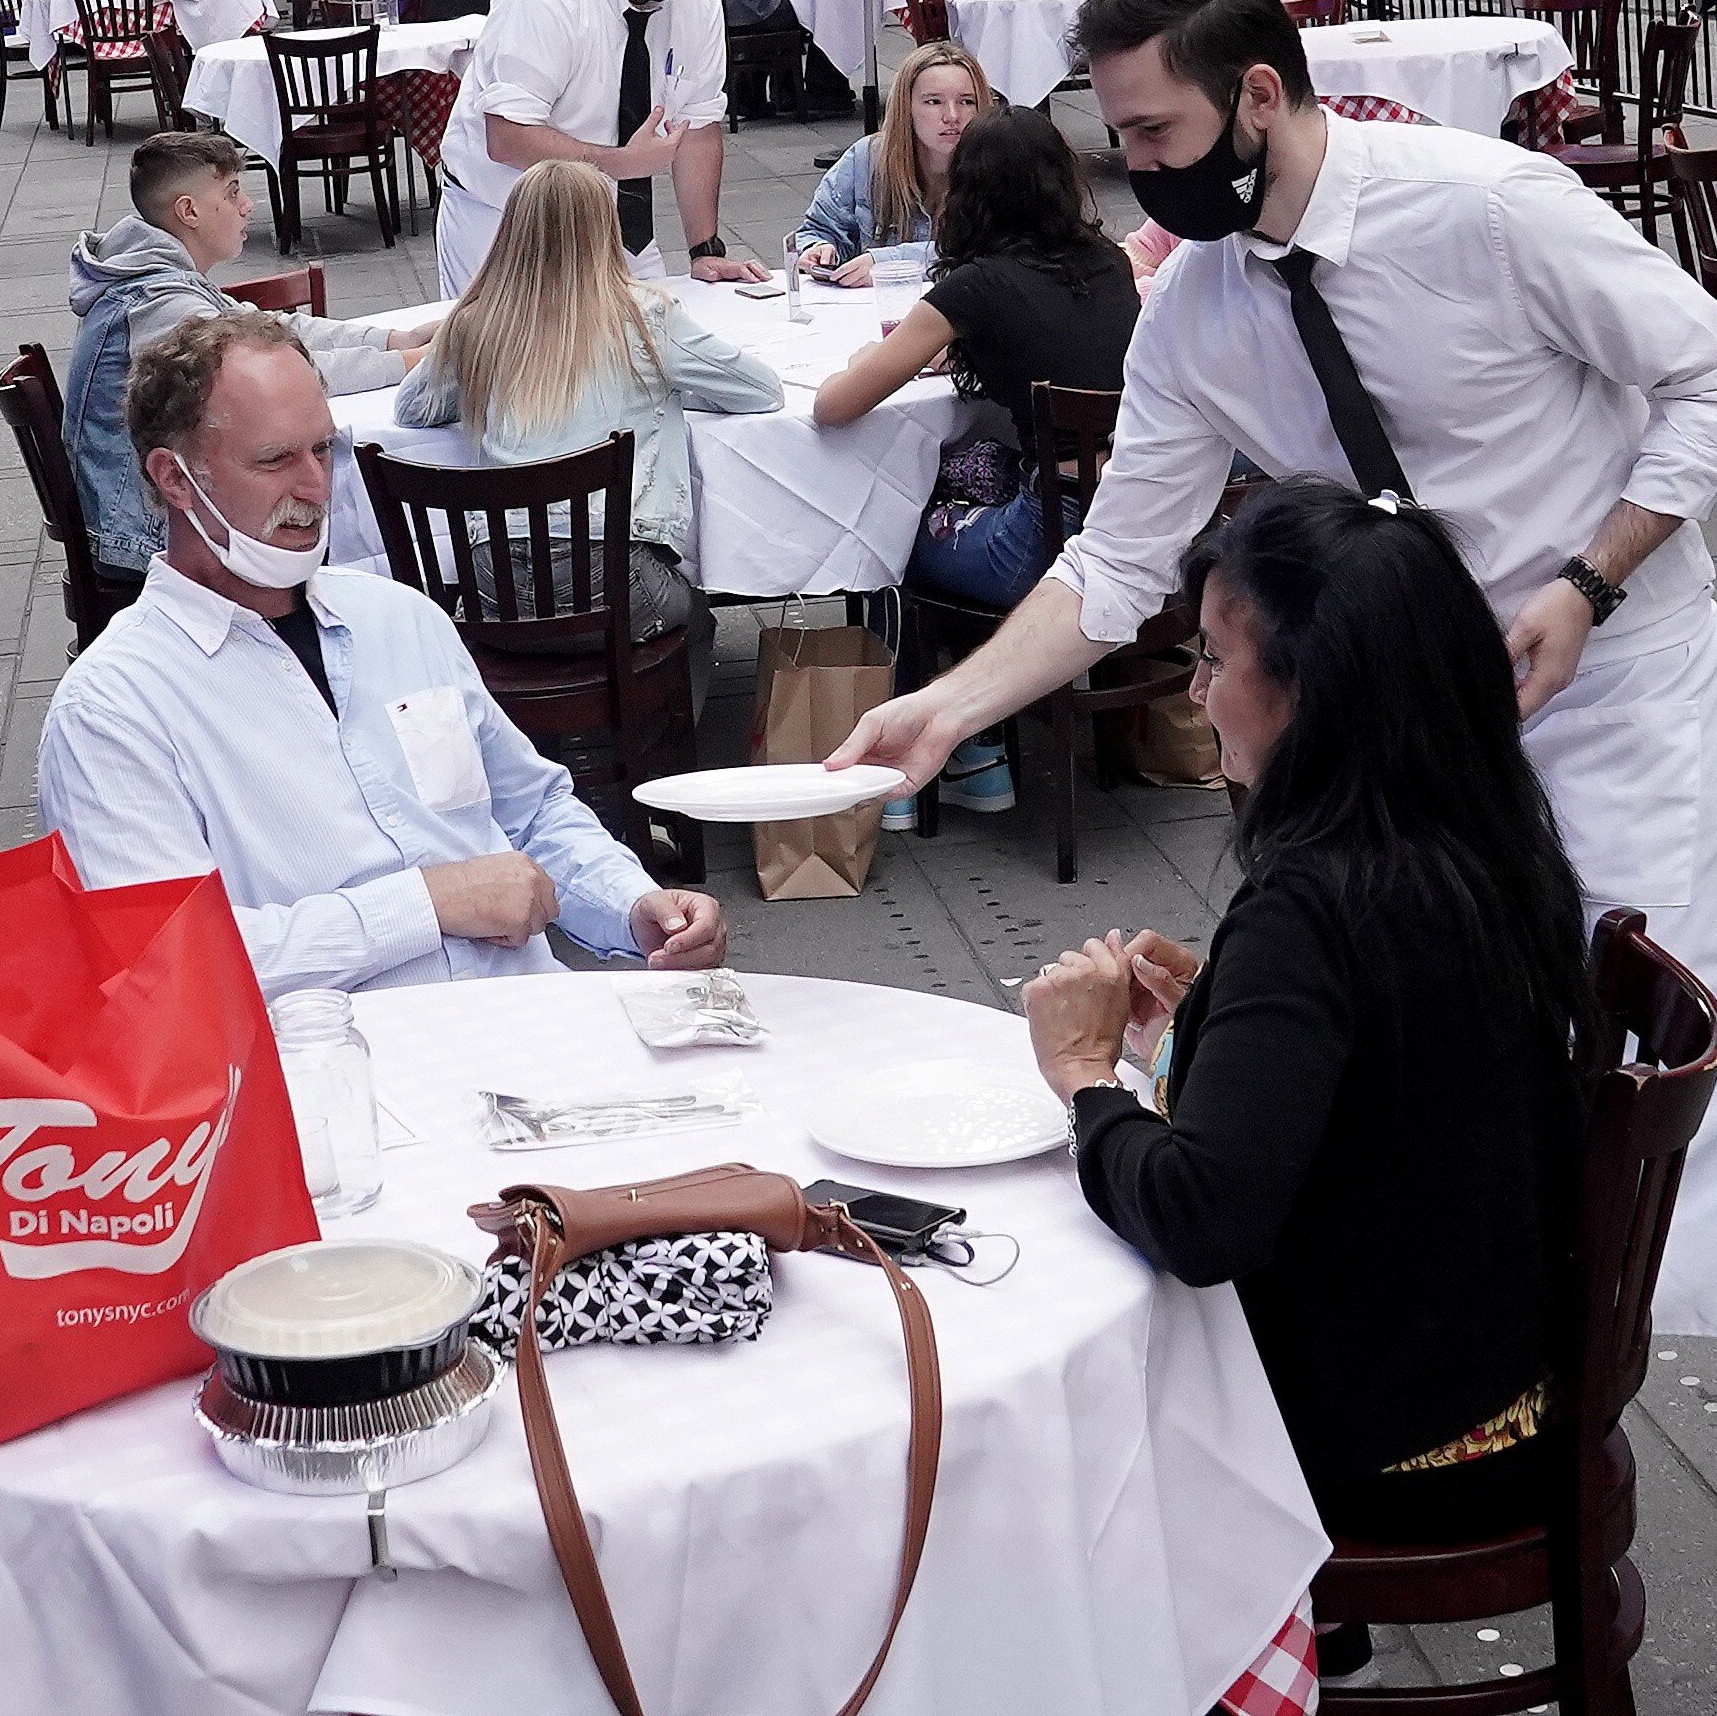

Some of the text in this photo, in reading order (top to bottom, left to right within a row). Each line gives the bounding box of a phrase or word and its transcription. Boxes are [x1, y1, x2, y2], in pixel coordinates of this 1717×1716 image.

[9, 1202, 174, 1239] Di Napoli
[57, 1288, 191, 1327] tonysnyc.com
